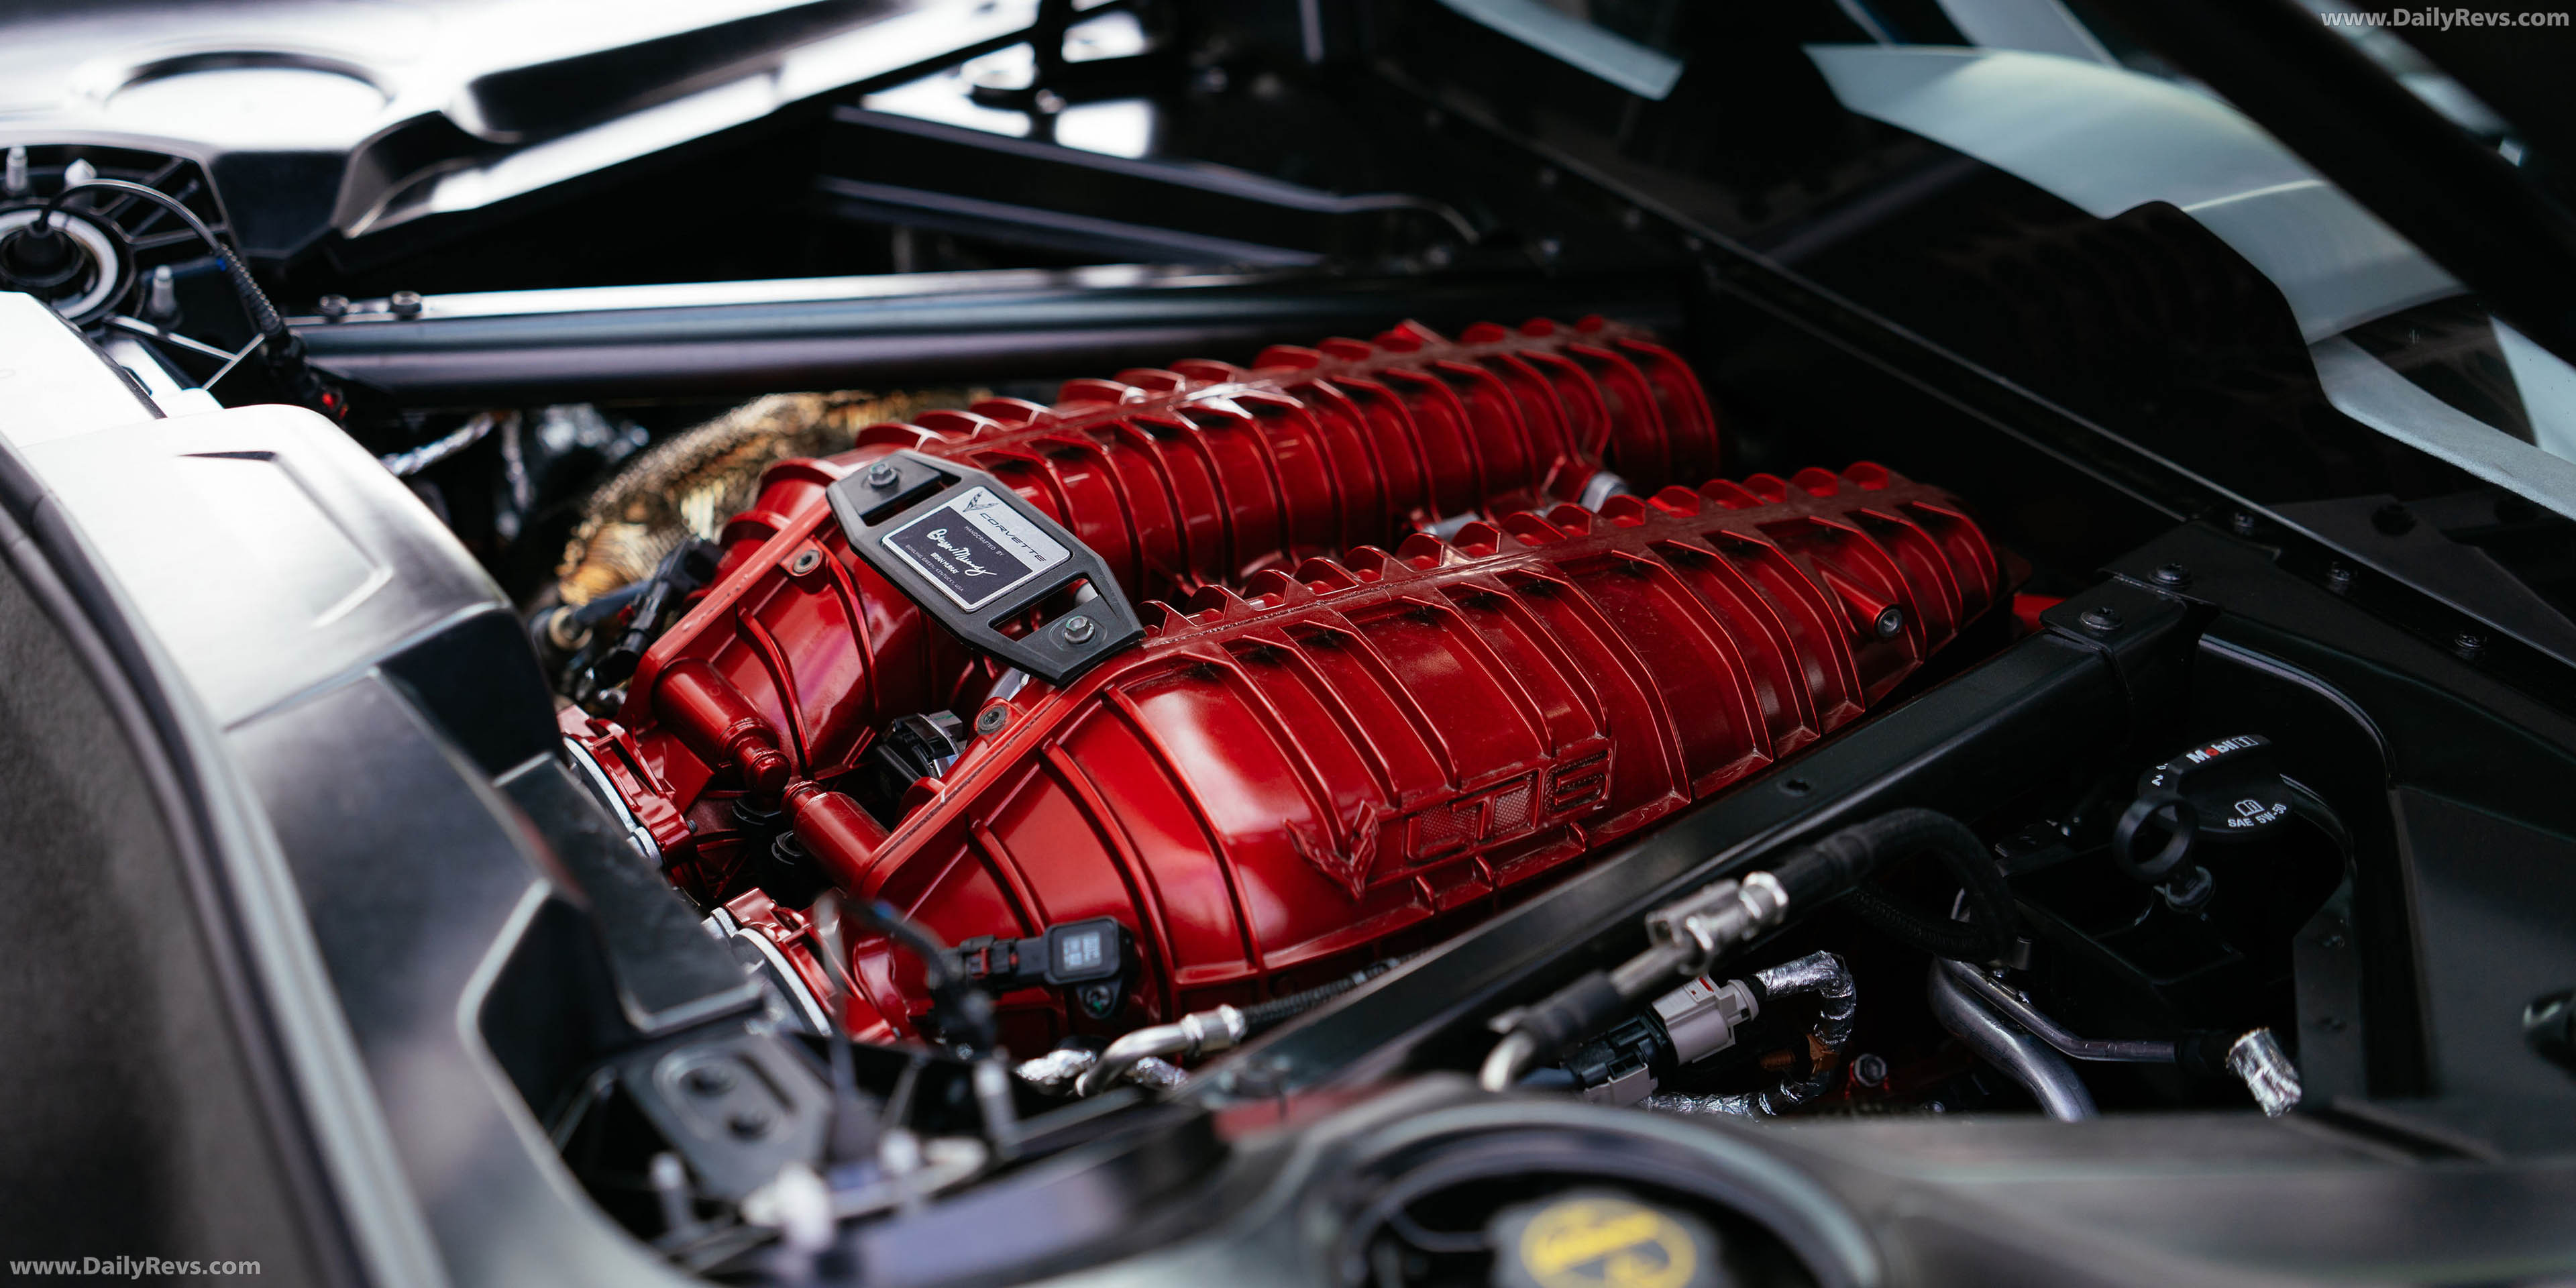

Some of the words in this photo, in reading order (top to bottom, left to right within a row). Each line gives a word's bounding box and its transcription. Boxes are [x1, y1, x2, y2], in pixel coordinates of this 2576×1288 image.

[965, 525, 996, 551] HANDCRAFTED
[980, 513, 1046, 561] CORVETTE
[2186, 740, 2239, 763] Mobil
[2227, 818, 2255, 827] SAE
[2255, 803, 2287, 824] 5W-50
